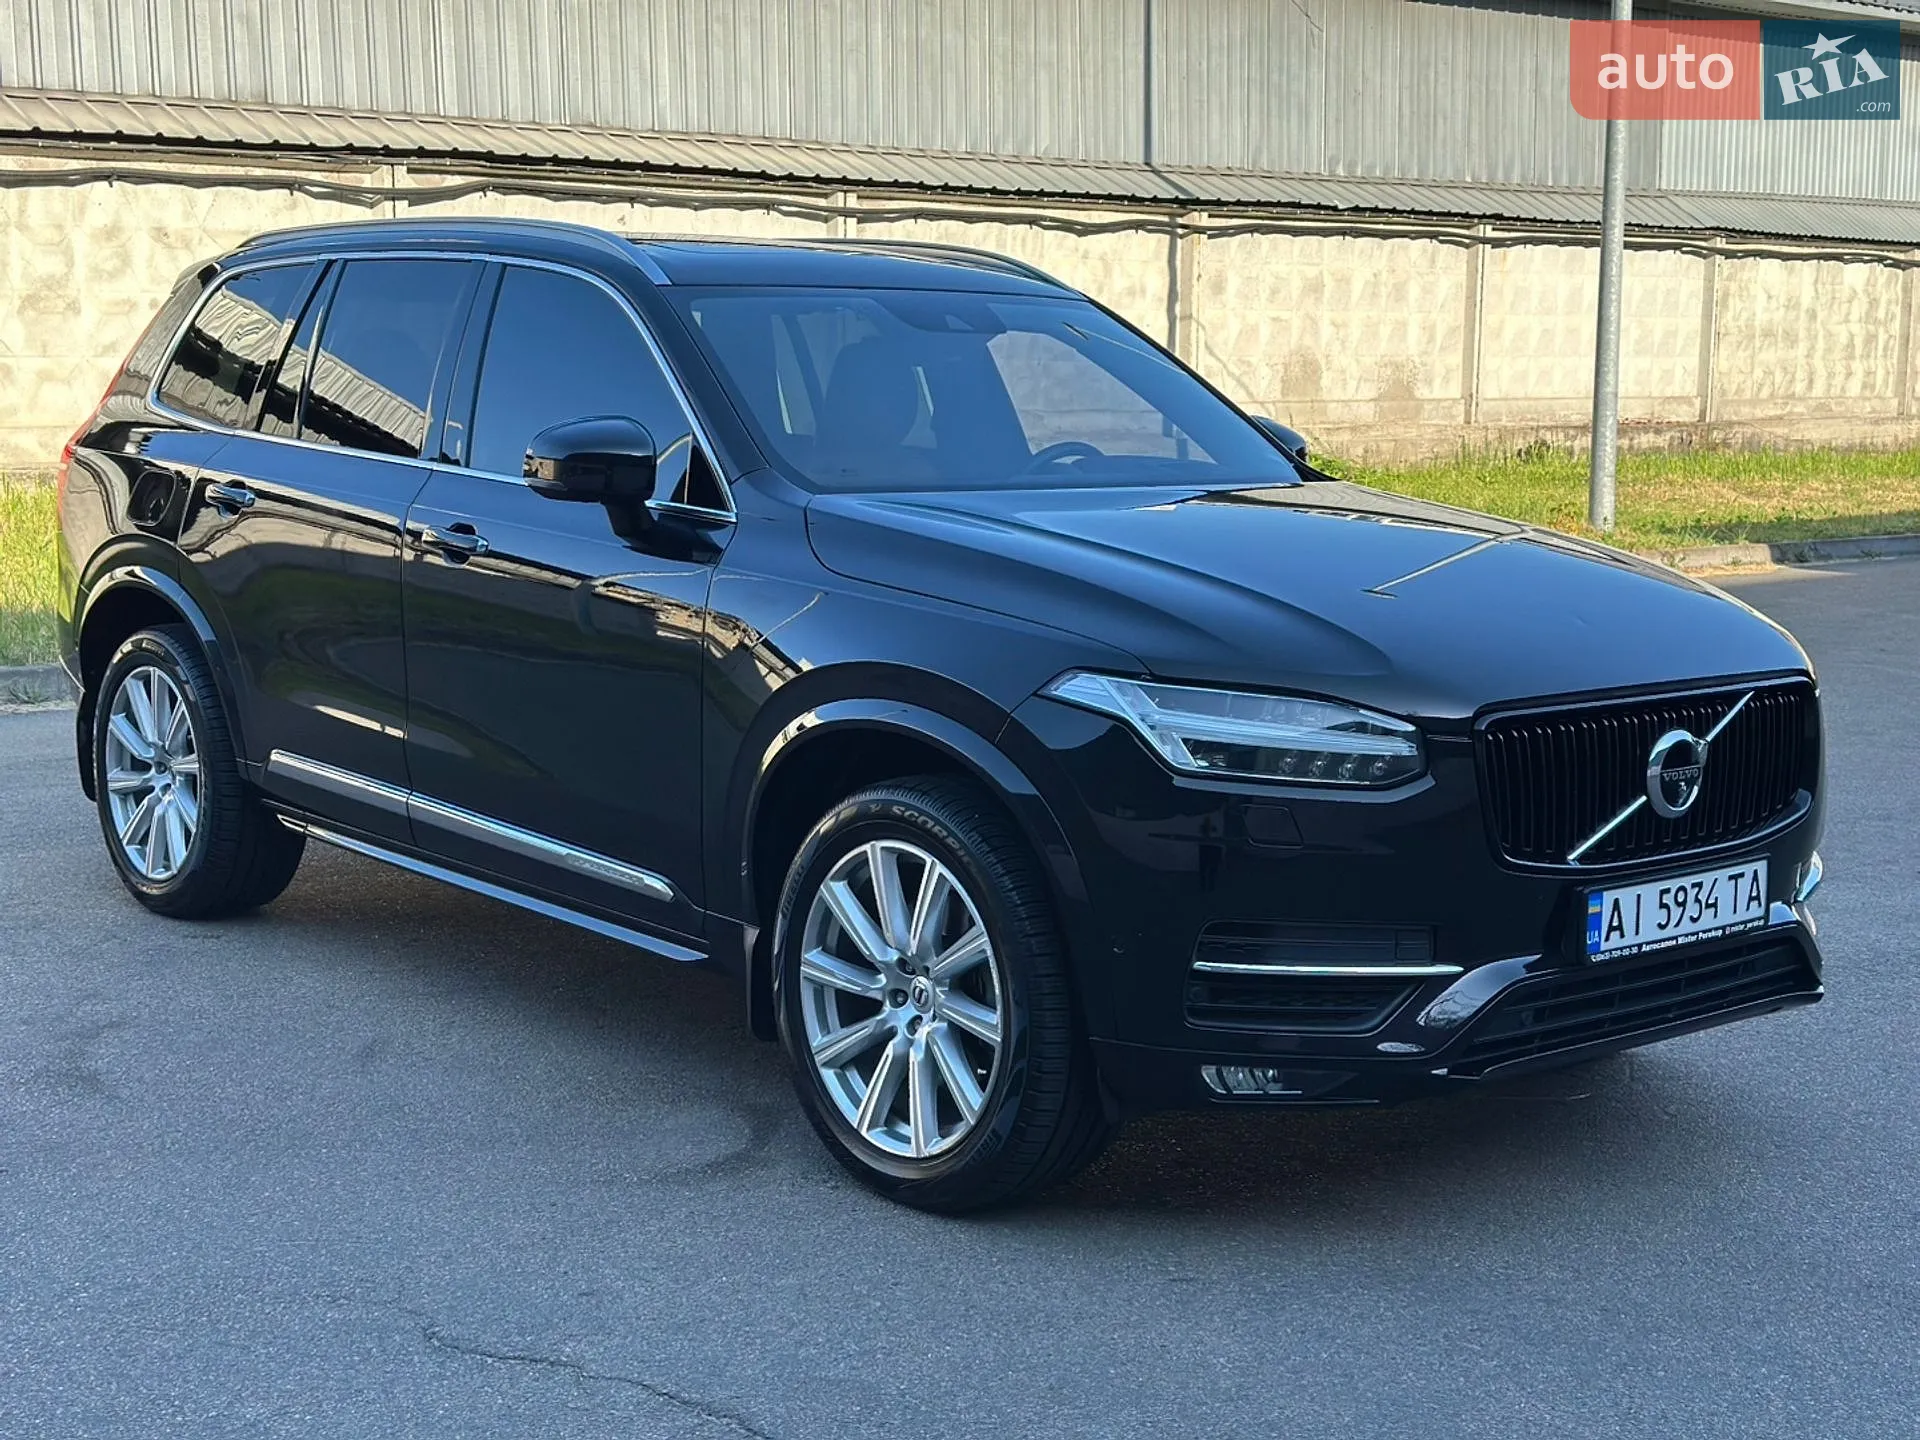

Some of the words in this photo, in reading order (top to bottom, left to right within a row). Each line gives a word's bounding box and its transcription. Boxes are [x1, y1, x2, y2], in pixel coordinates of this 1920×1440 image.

[1662, 768, 1699, 781] VOLVO
[1604, 893, 1641, 942] AI
[1657, 878, 1719, 931] 5934
[1728, 868, 1762, 915] TA
[1586, 931, 1600, 945] UA
